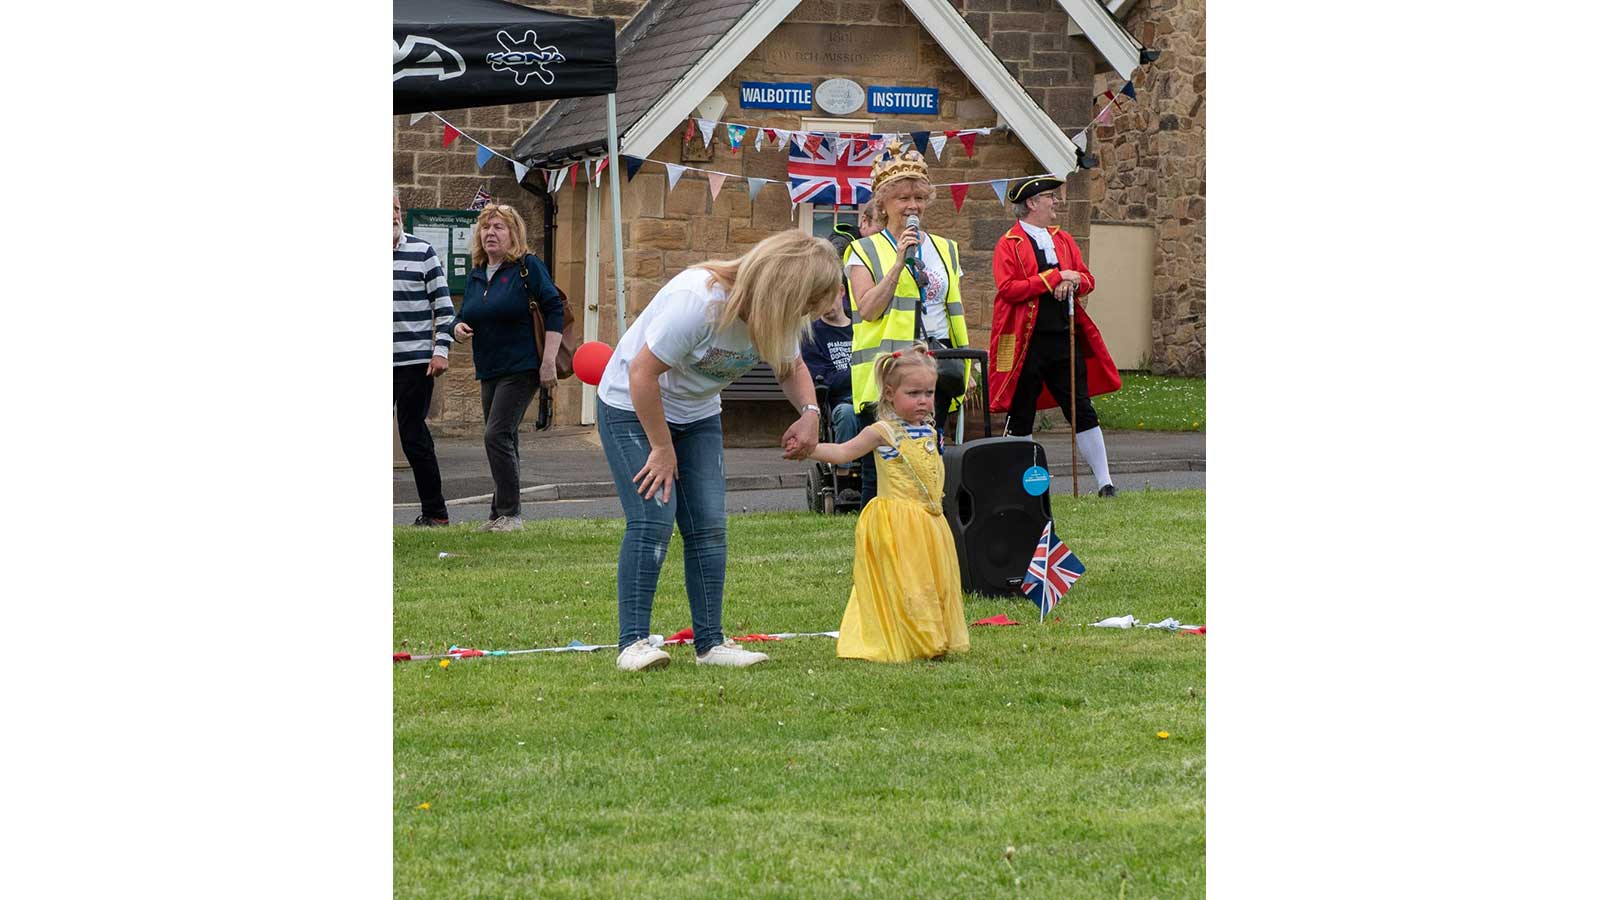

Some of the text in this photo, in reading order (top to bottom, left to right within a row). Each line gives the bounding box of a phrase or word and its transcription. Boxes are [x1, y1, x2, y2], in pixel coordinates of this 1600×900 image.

[486, 51, 567, 64] KONA
[742, 87, 811, 104] WALBOTTLE
[872, 92, 933, 108] INSTITUTE
